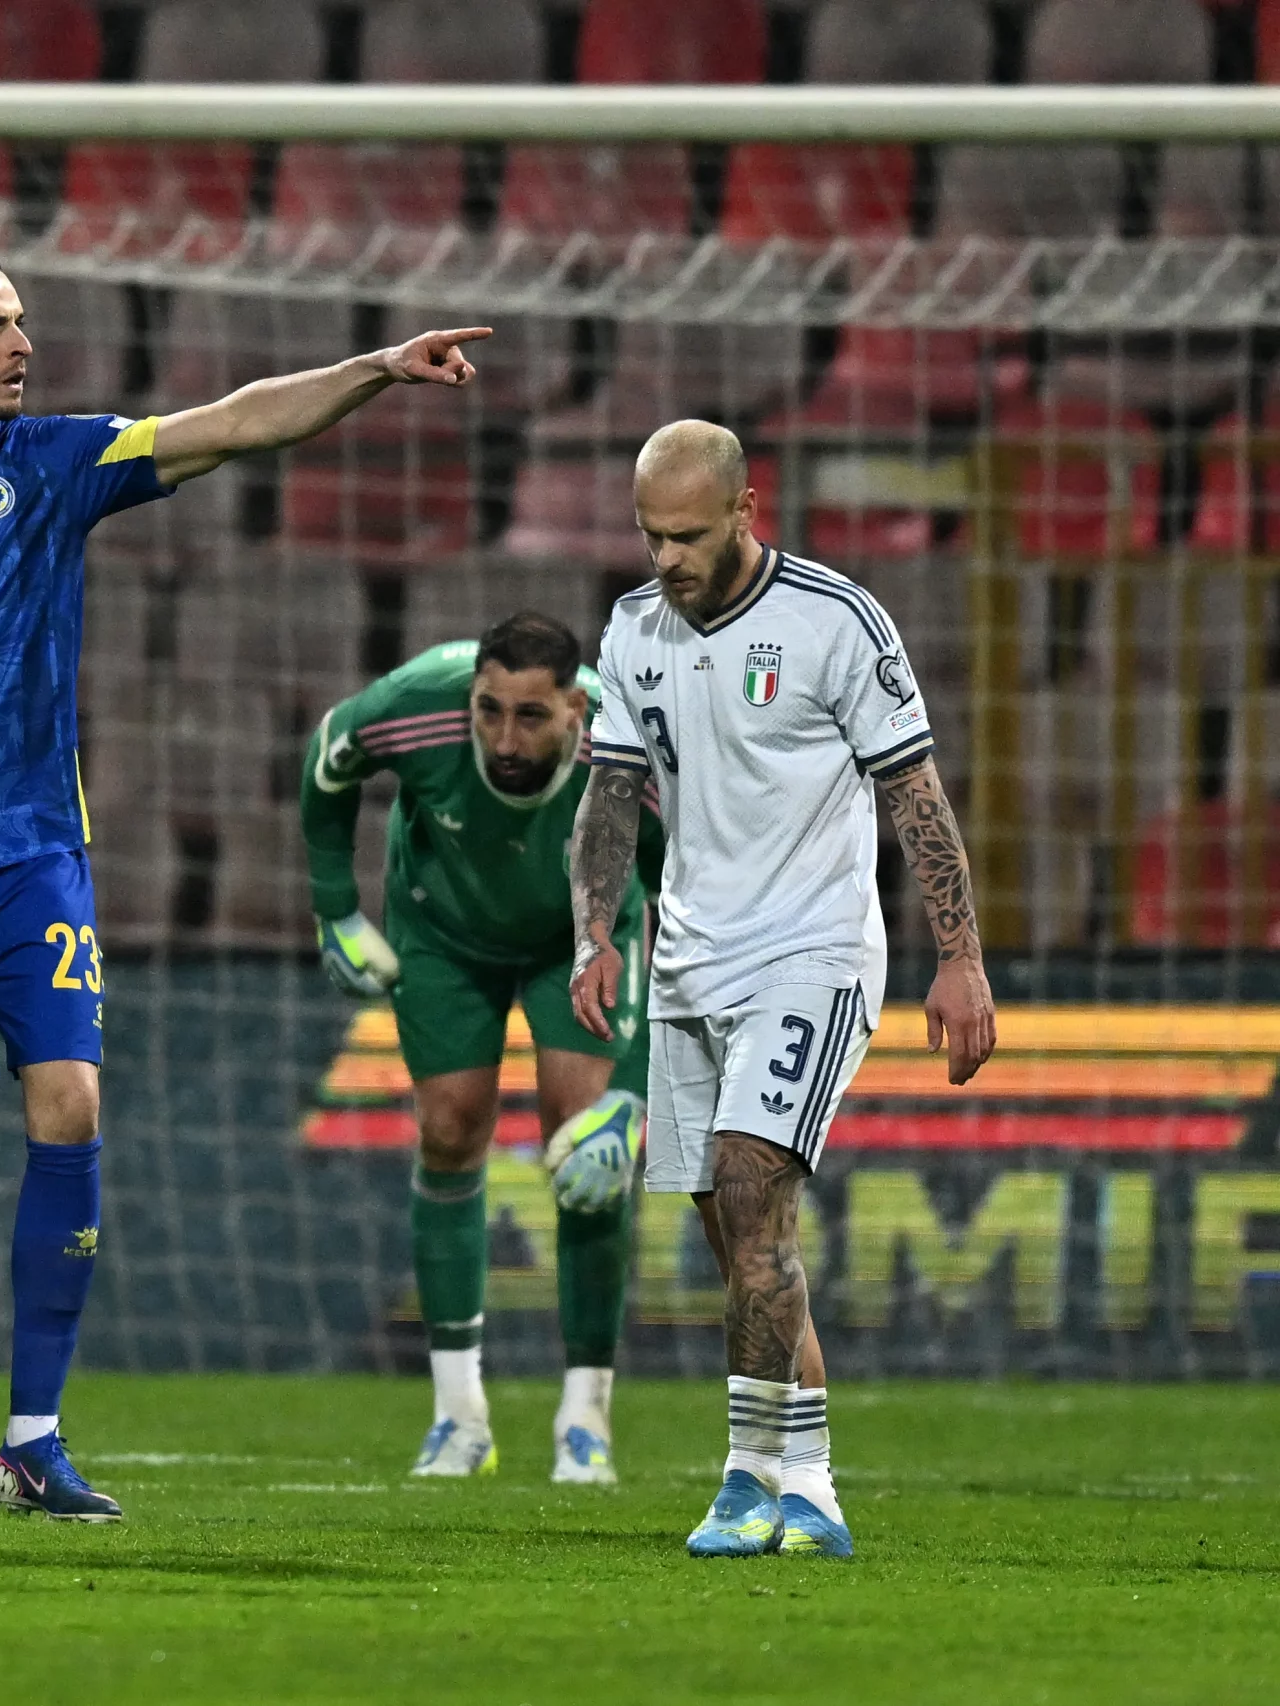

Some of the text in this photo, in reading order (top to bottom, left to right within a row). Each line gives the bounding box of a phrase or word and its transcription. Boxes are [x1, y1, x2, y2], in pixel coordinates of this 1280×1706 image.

[749, 656, 777, 668] ITALIA
[641, 706, 679, 773] 3
[44, 922, 102, 994] 23
[768, 1014, 816, 1085] 3
